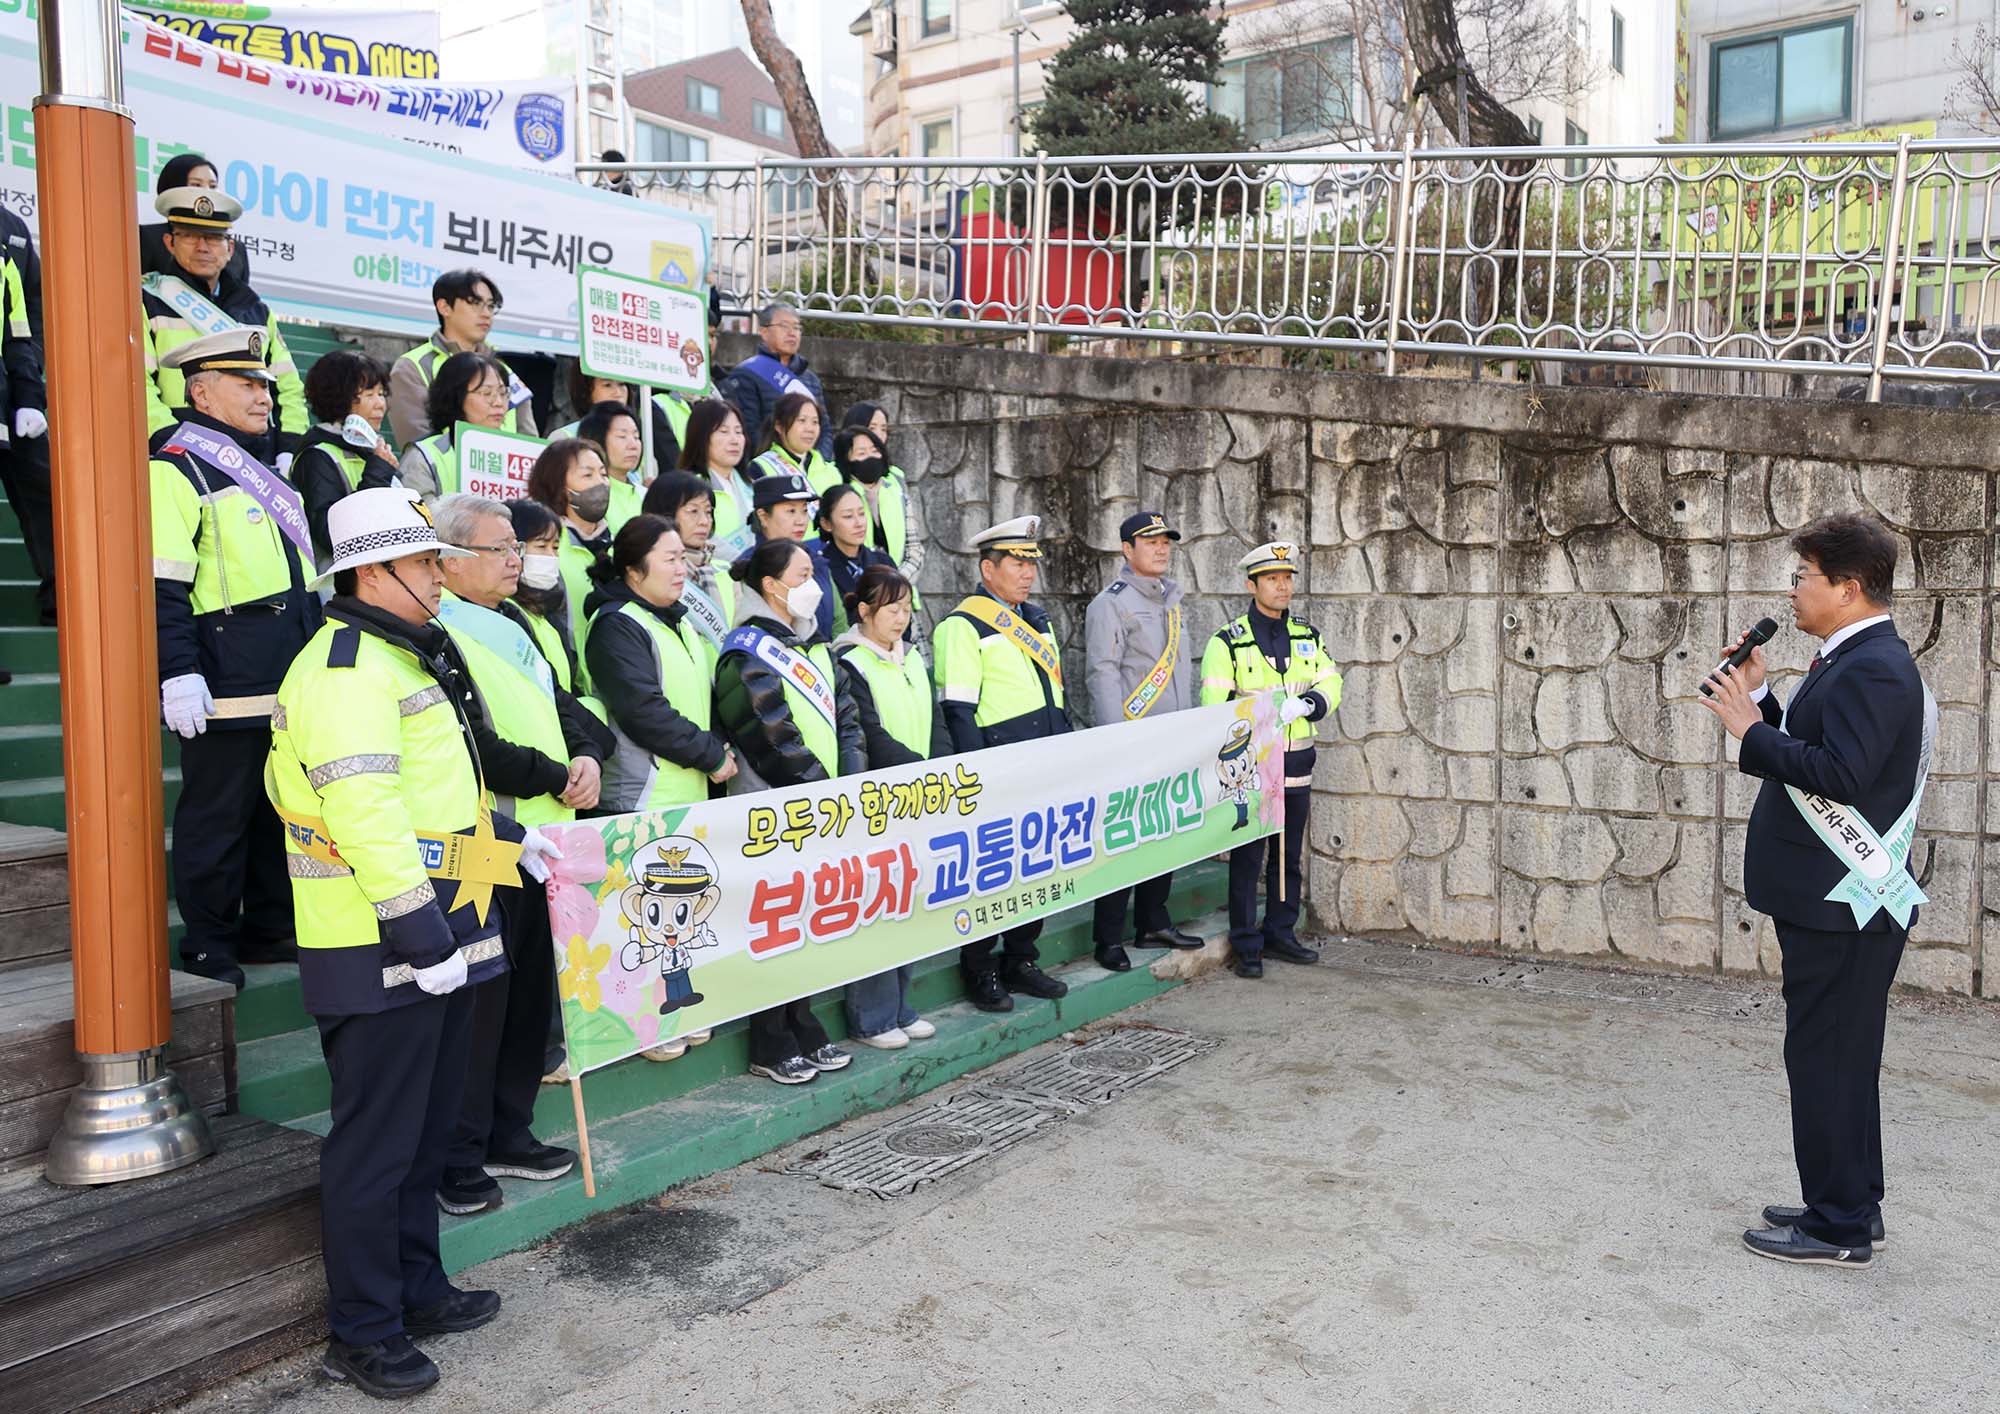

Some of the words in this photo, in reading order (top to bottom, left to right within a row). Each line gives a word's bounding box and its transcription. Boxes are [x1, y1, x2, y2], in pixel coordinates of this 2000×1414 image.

[225, 160, 328, 228] 아이
[344, 184, 434, 248] 먼저
[444, 211, 613, 274] 보내주세요
[590, 287, 618, 310] 매월
[591, 314, 662, 346] 안전점검의
[667, 330, 679, 349] 날
[470, 448, 502, 475] 매월
[742, 792, 855, 857] 모두가
[859, 763, 982, 836] 함께하는
[749, 843, 918, 954] 보행자
[928, 796, 1095, 905] 교통안전
[1103, 768, 1203, 850] 캠페인
[975, 878, 1075, 924] 대전대덕경찰서
